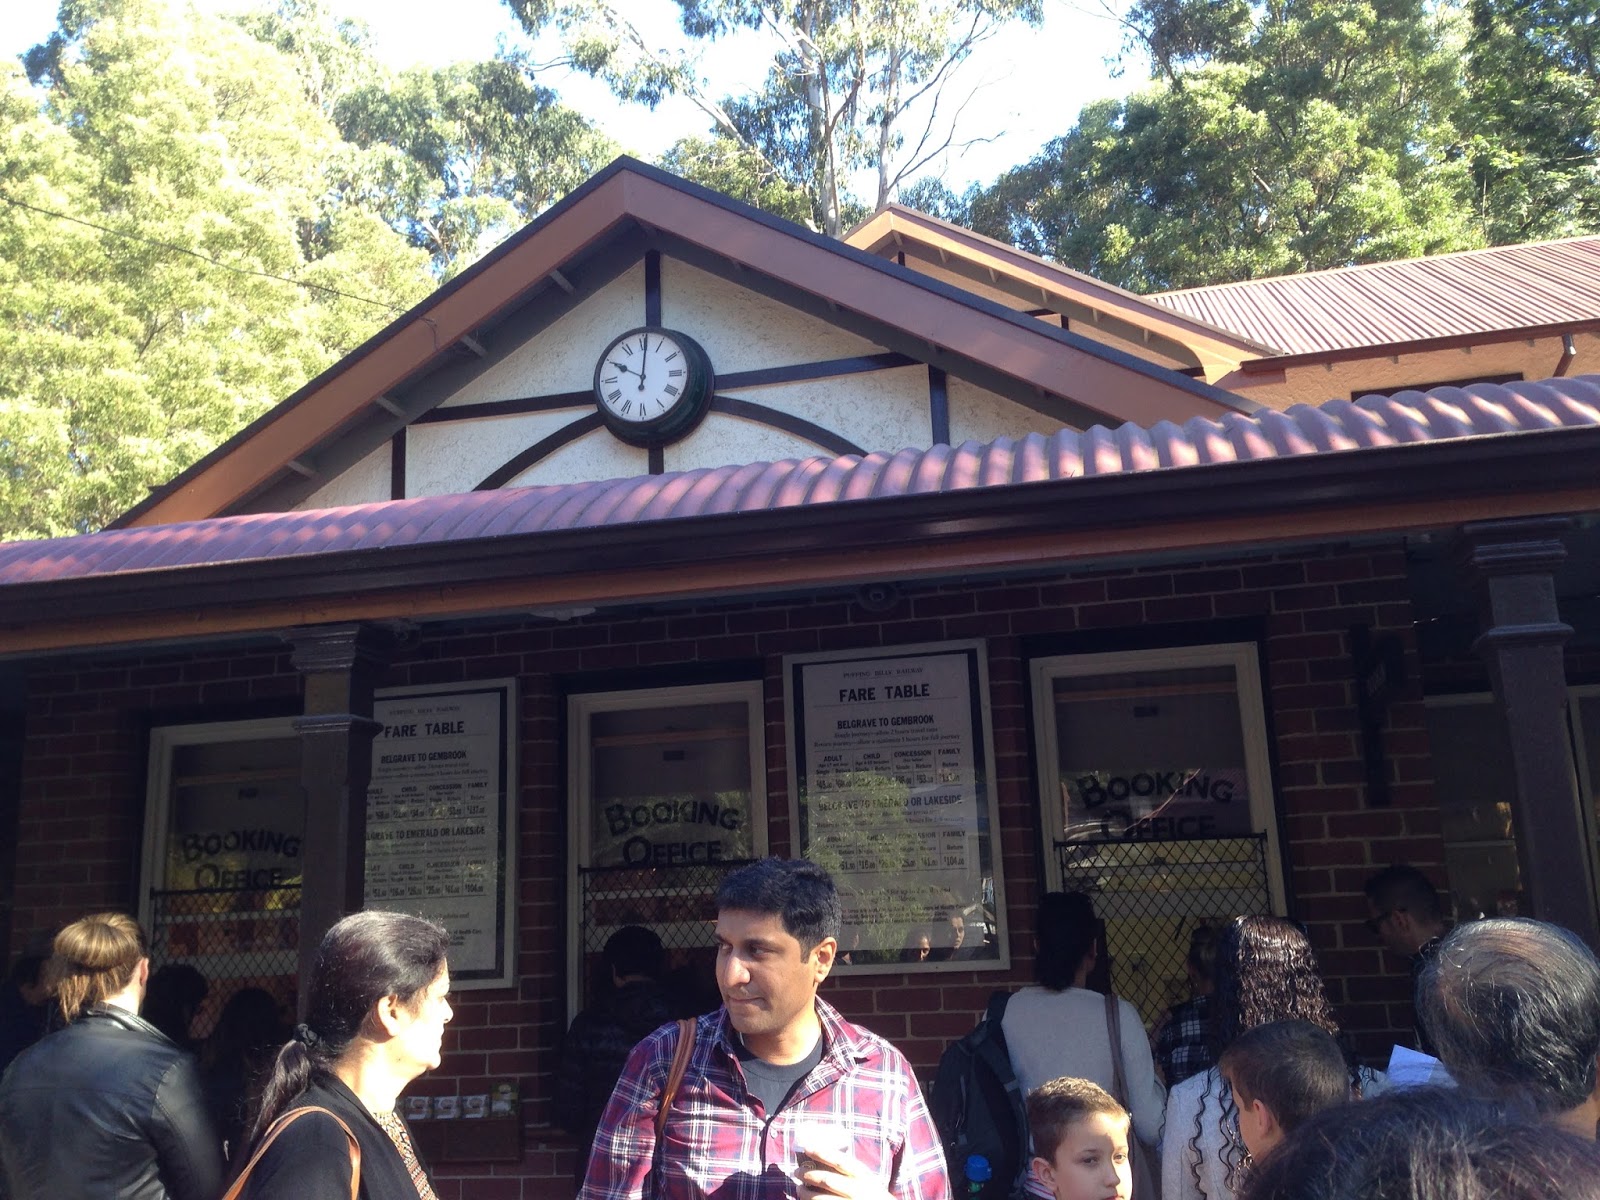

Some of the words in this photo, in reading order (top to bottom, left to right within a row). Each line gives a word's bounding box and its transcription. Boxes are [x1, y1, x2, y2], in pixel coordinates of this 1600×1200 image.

[839, 687, 876, 703] FARE
[885, 683, 930, 700] TABLE
[384, 724, 417, 738] FARE
[424, 720, 465, 735] TABLE
[837, 718, 877, 730] BELGRAVE
[879, 717, 889, 726] TO
[890, 714, 934, 726] GEMBROOK
[381, 753, 416, 764] BELGRAVE
[417, 752, 427, 762] TO
[428, 750, 467, 761] GEMBROOK
[823, 754, 843, 762] ADULT
[863, 752, 881, 760] CHILD
[894, 749, 932, 758] CONCESSION
[938, 747, 961, 755] FAMILY
[1076, 771, 1234, 809] BOOKING
[911, 796, 922, 806] OR
[923, 794, 962, 806] LAKESIDE
[604, 800, 740, 837] BOOKING
[1100, 810, 1216, 840] OFFICE
[396, 830, 405, 839] TO
[406, 829, 439, 839] EMERALD
[440, 828, 450, 837] OR
[943, 830, 966, 838] FAMILY
[182, 828, 302, 864] BOOKING
[622, 836, 721, 866] OFFICE
[194, 863, 282, 889] OFFICE
